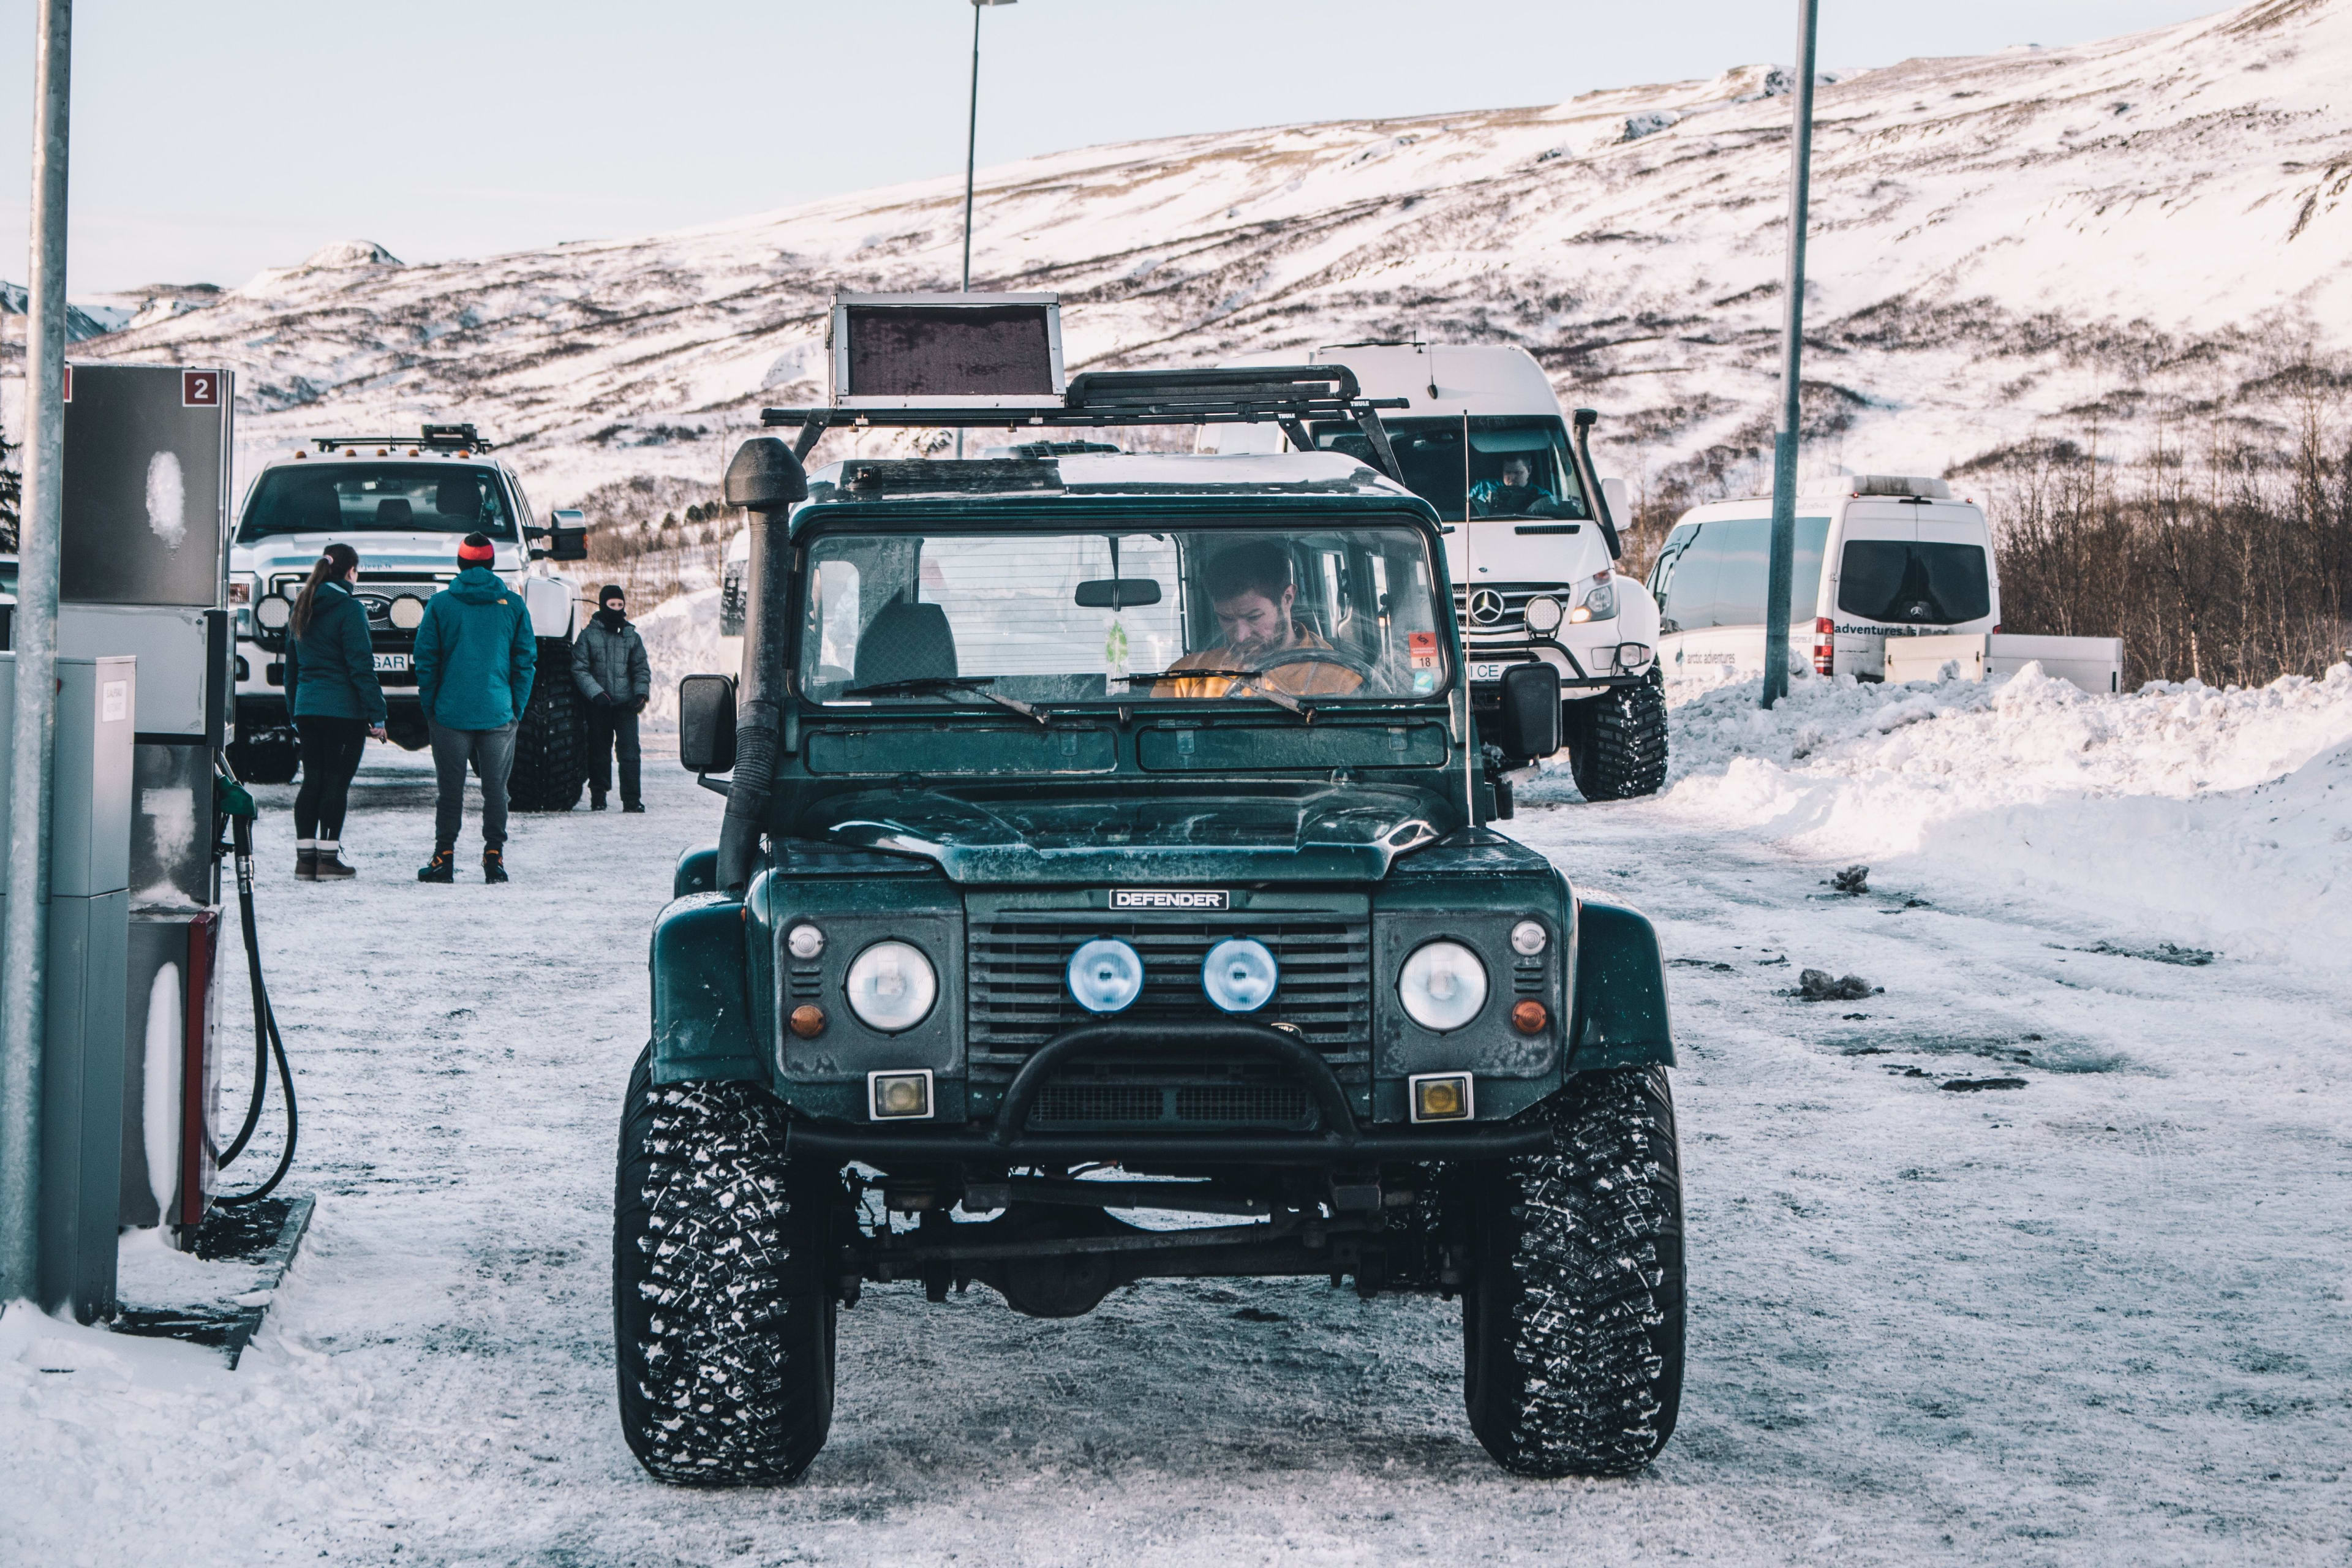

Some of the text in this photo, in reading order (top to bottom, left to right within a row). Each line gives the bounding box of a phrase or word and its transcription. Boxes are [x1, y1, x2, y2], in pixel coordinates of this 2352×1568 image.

[195, 379, 208, 399] 2
[1834, 624, 1917, 636] adventures.is
[373, 656, 405, 668] GAR
[1420, 657, 1431, 667] 18
[1687, 649, 1735, 664] arctic adventures
[1470, 665, 1509, 677] ICE
[1117, 893, 1219, 907] DEFENDER
